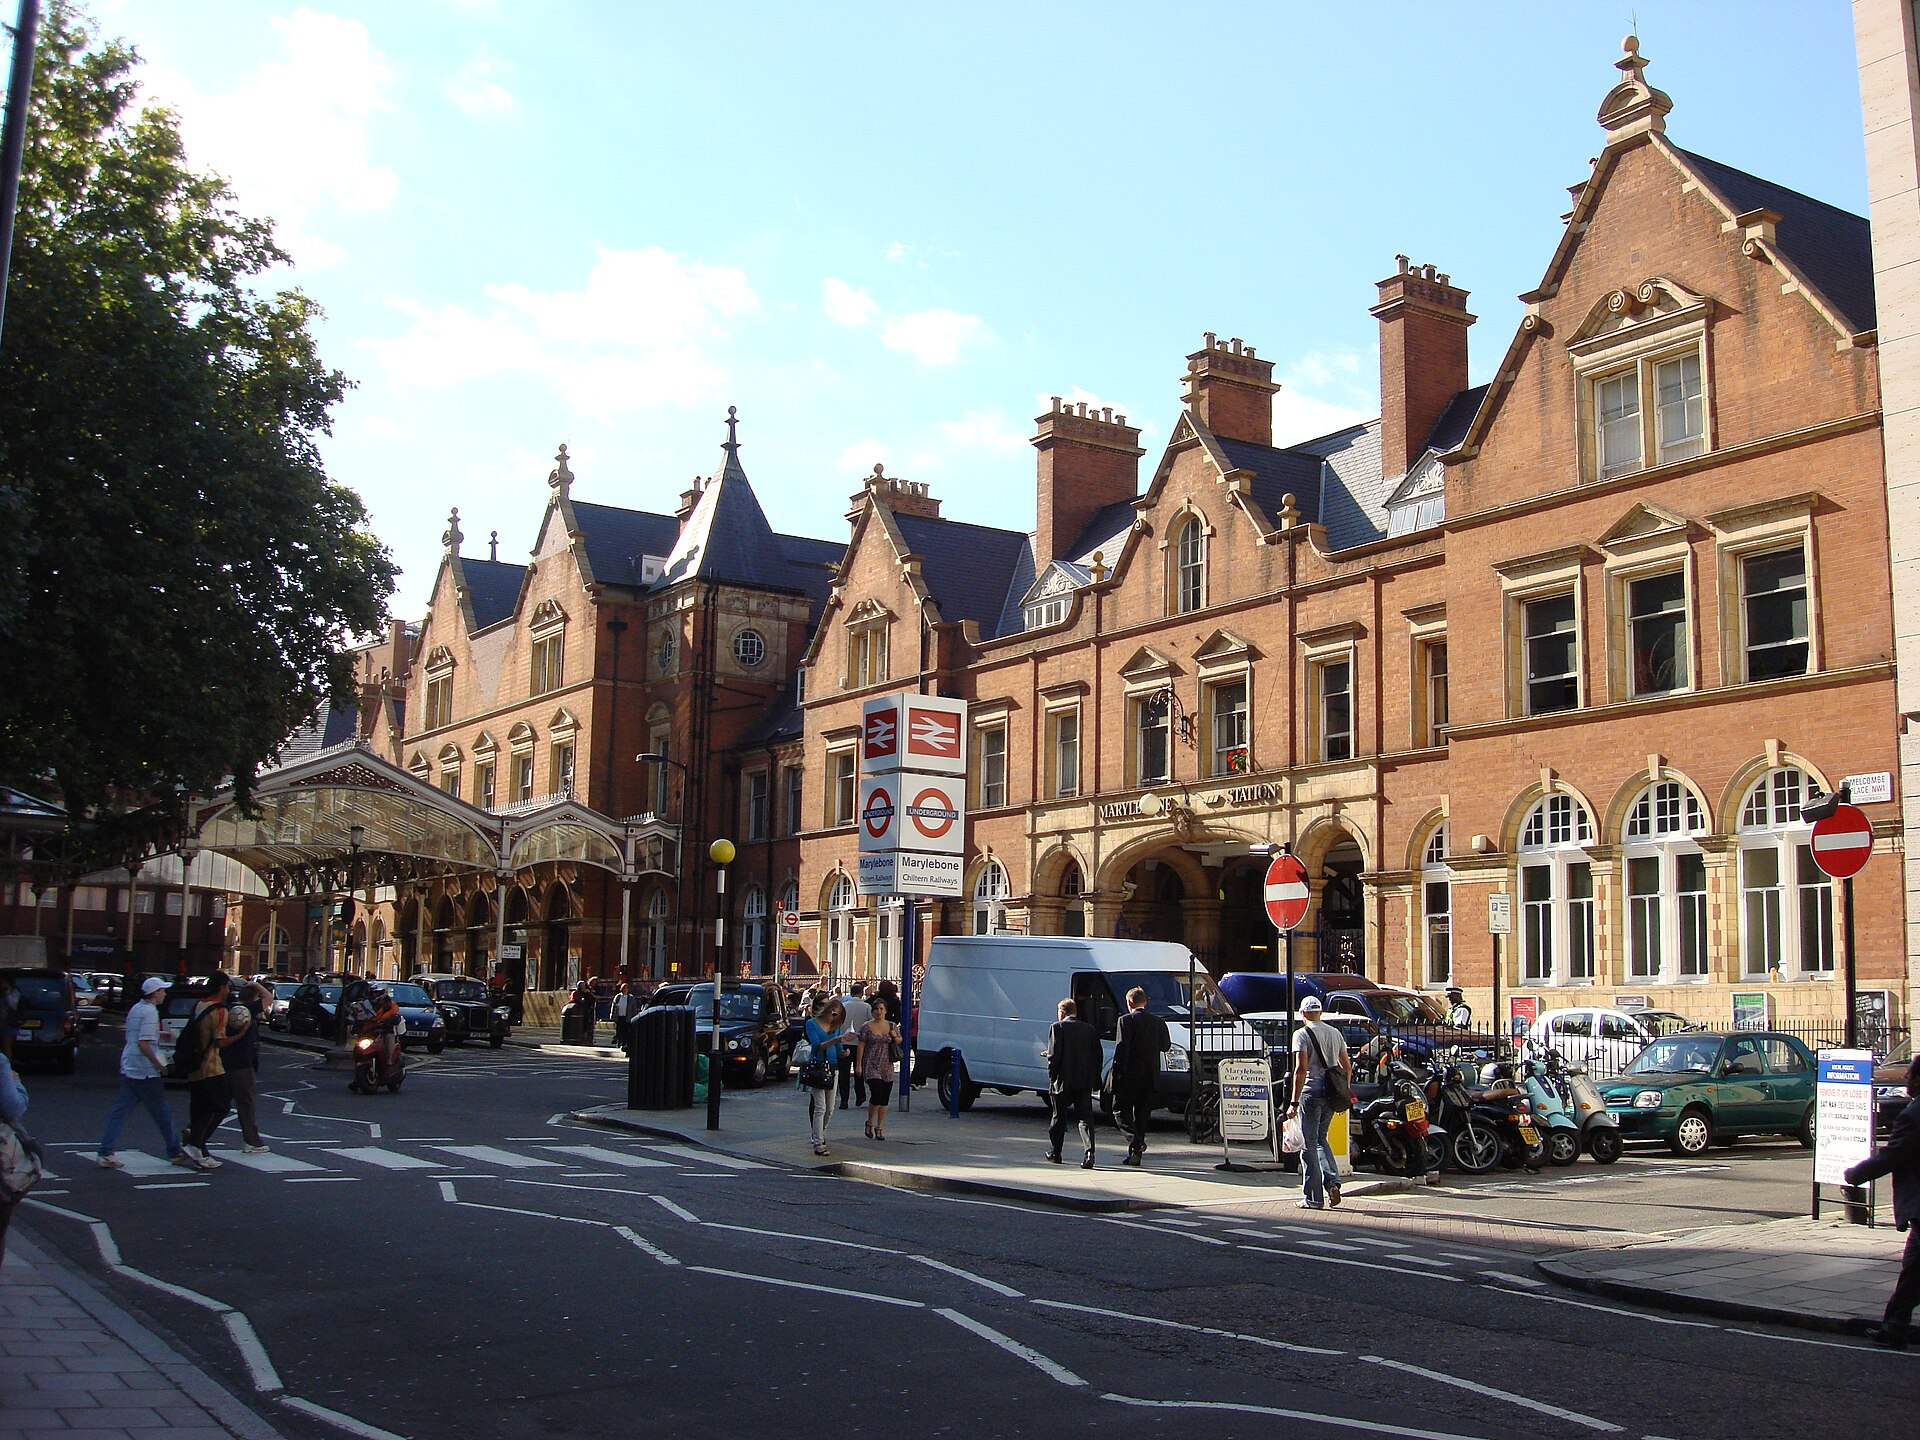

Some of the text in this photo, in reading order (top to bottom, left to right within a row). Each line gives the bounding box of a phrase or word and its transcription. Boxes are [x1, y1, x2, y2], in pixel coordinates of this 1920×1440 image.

[1850, 776, 1885, 786] MELCOMBE
[1871, 785, 1885, 793] NW1
[1099, 783, 1279, 818] MARYLENE STATION
[864, 808, 893, 818] UNDERGROUND
[909, 808, 956, 818] UNDERGROUND
[859, 858, 894, 870] Marylebone
[902, 857, 959, 871] Marylebone
[902, 874, 958, 885] Chiltern Railways
[1225, 1068, 1266, 1076] Marylebone
[1842, 1090, 1849, 1098] OR
[1849, 1090, 1862, 1099] LOSE
